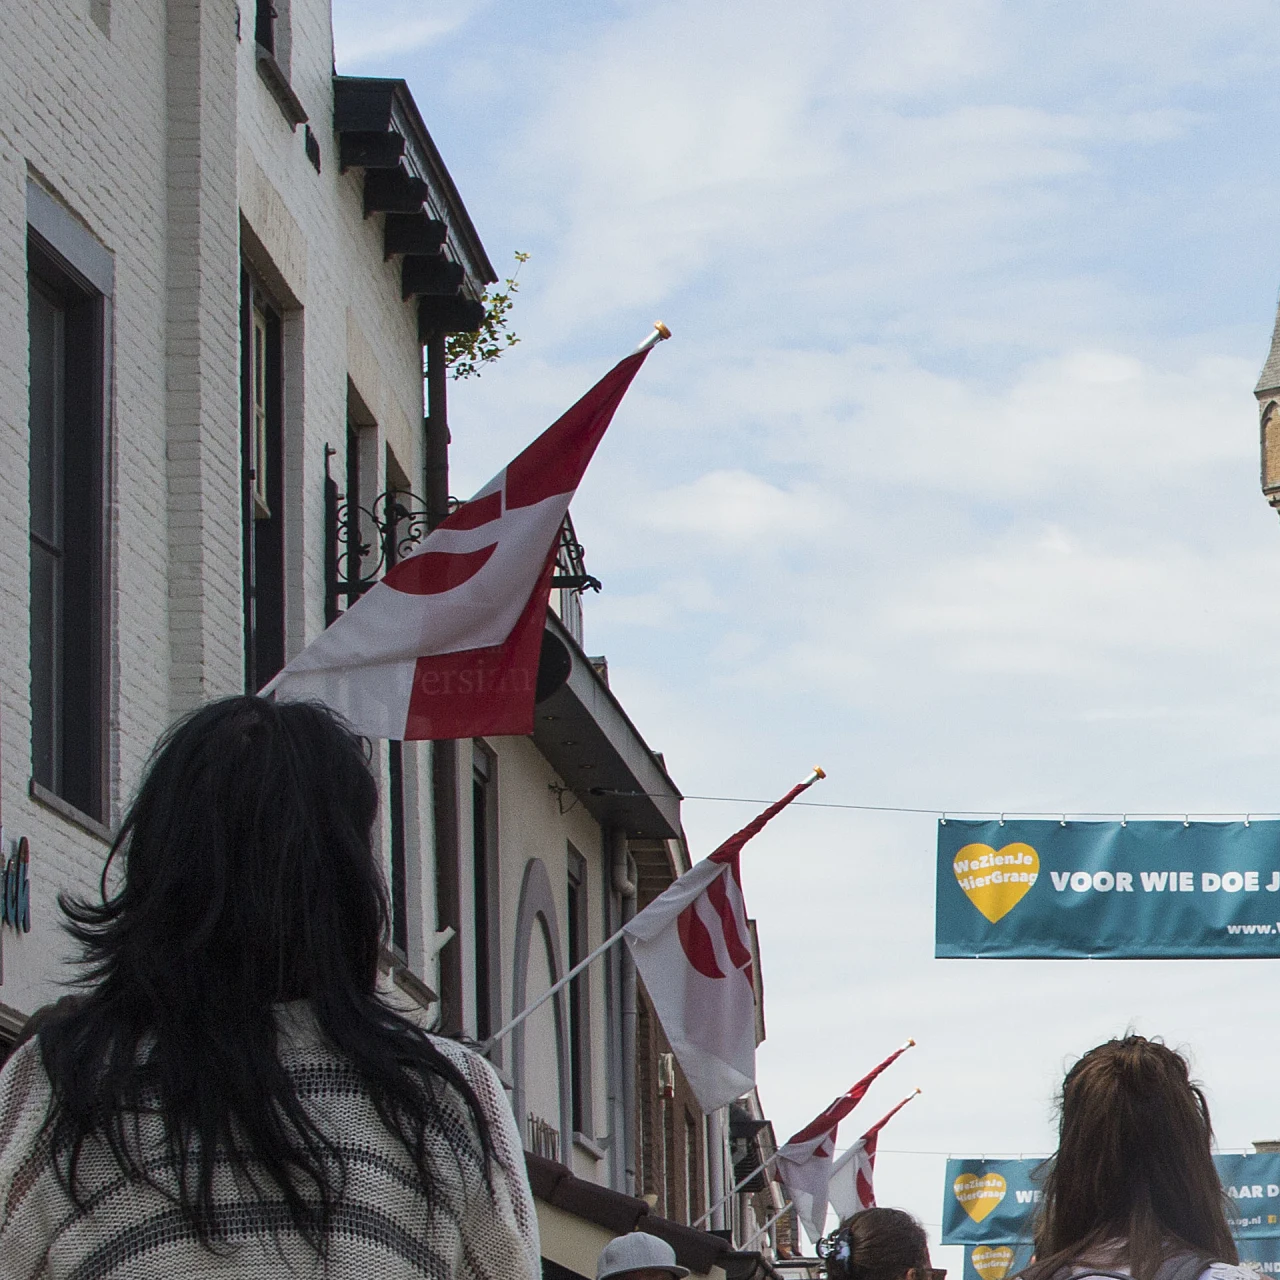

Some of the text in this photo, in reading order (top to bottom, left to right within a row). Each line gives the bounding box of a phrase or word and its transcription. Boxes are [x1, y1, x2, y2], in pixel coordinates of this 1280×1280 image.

[411, 659, 534, 697] ersin
[953, 852, 1033, 874] WeZienJe
[1050, 871, 1135, 892] VOOR
[1140, 871, 1195, 892] WIE
[1201, 871, 1260, 893] DOE
[1227, 1185, 1263, 1199] AAR
